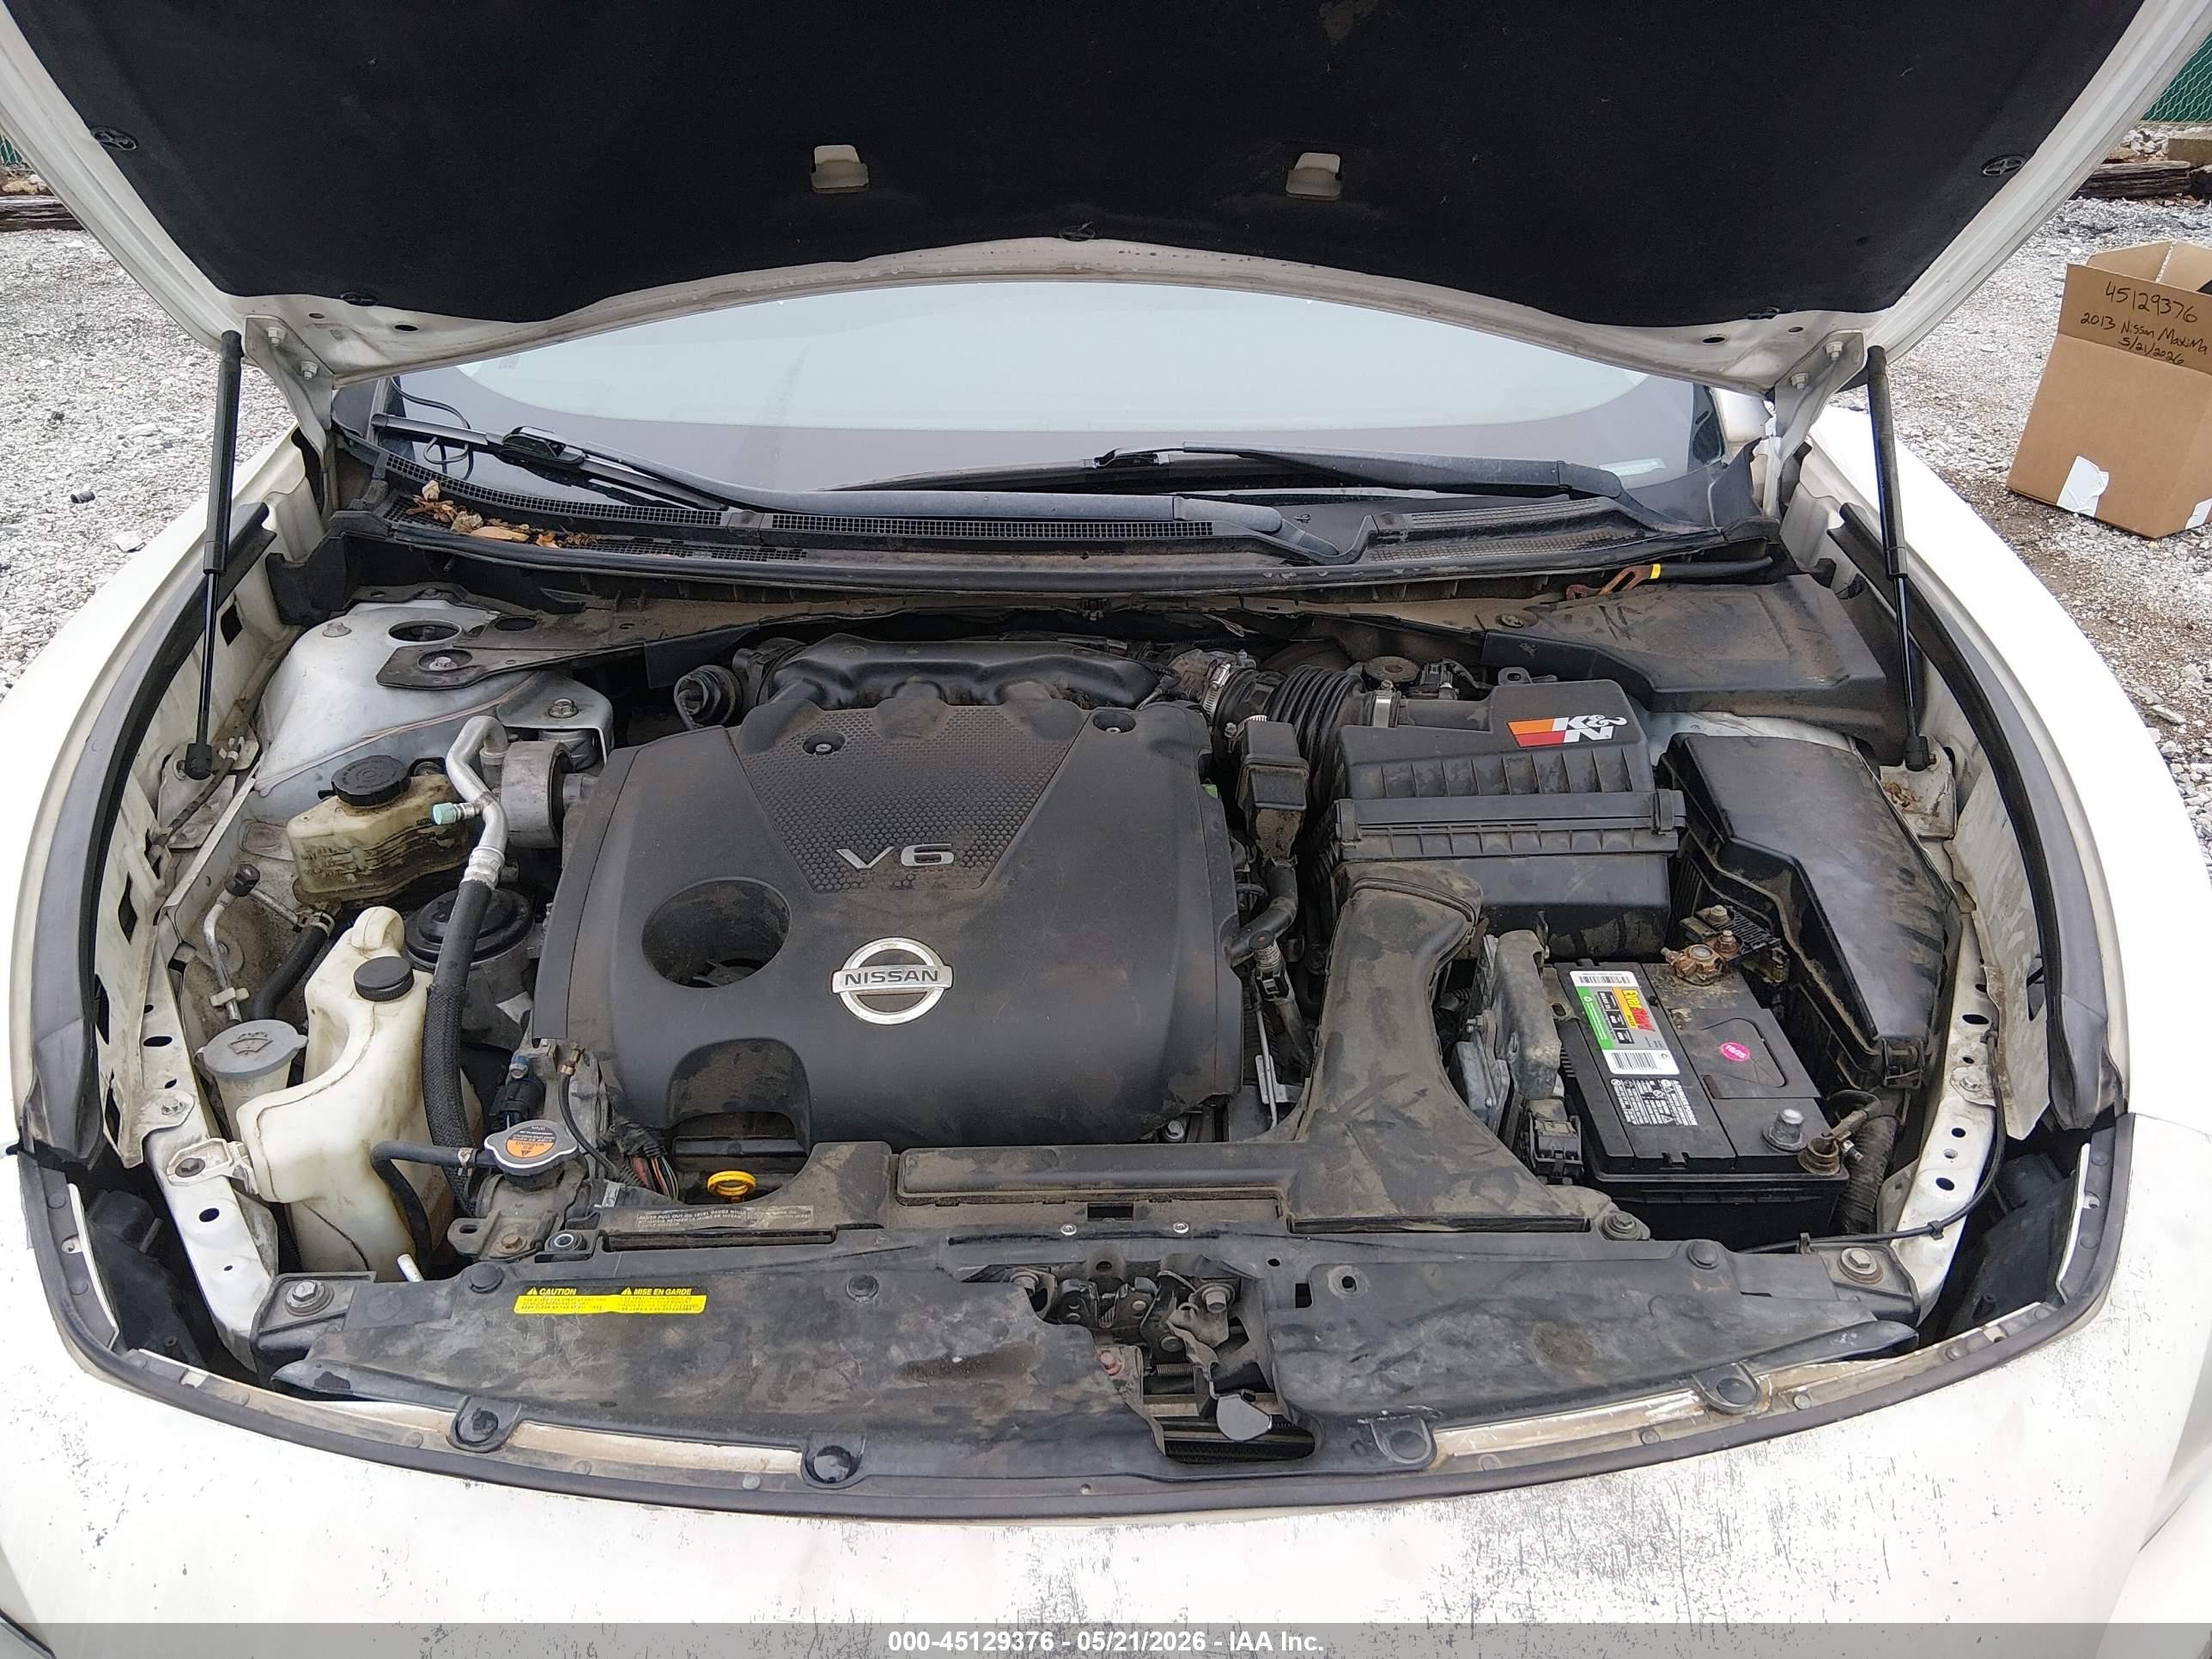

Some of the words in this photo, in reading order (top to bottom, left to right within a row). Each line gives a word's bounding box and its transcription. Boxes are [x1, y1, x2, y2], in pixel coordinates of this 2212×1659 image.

[2106, 282, 2197, 323] 45129376
[2081, 313, 2116, 330] 2013
[2120, 319, 2154, 337] Nissan
[2118, 337, 2185, 365] 5/21/2026
[1552, 714, 1628, 743] K&N
[836, 843, 955, 869] V6
[844, 969, 939, 986] NISSAN
